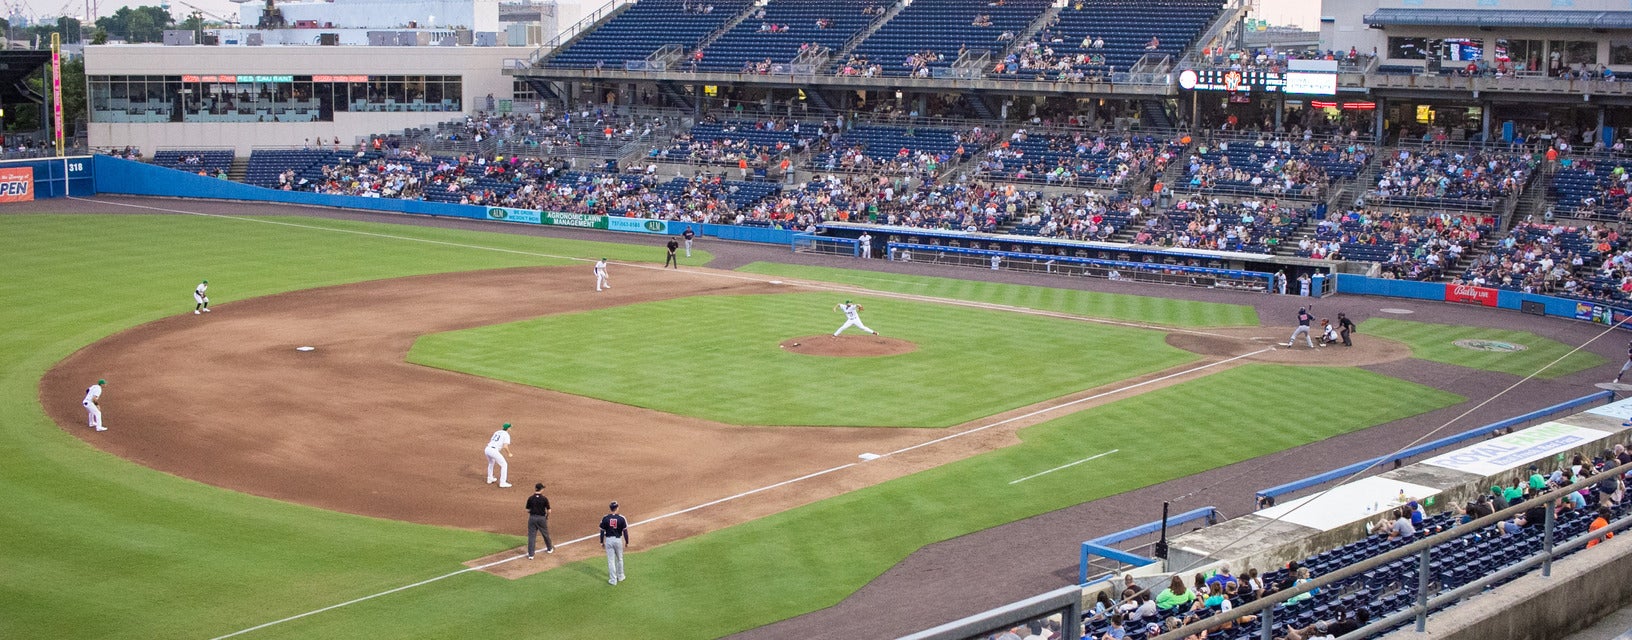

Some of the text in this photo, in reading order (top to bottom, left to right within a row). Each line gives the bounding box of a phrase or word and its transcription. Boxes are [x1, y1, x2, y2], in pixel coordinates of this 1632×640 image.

[69, 163, 83, 172] 318
[547, 211, 602, 222] AGRONOMIC LAWN
[553, 218, 594, 228] MANAGEMENT
[1434, 444, 1519, 467] ROYAL
